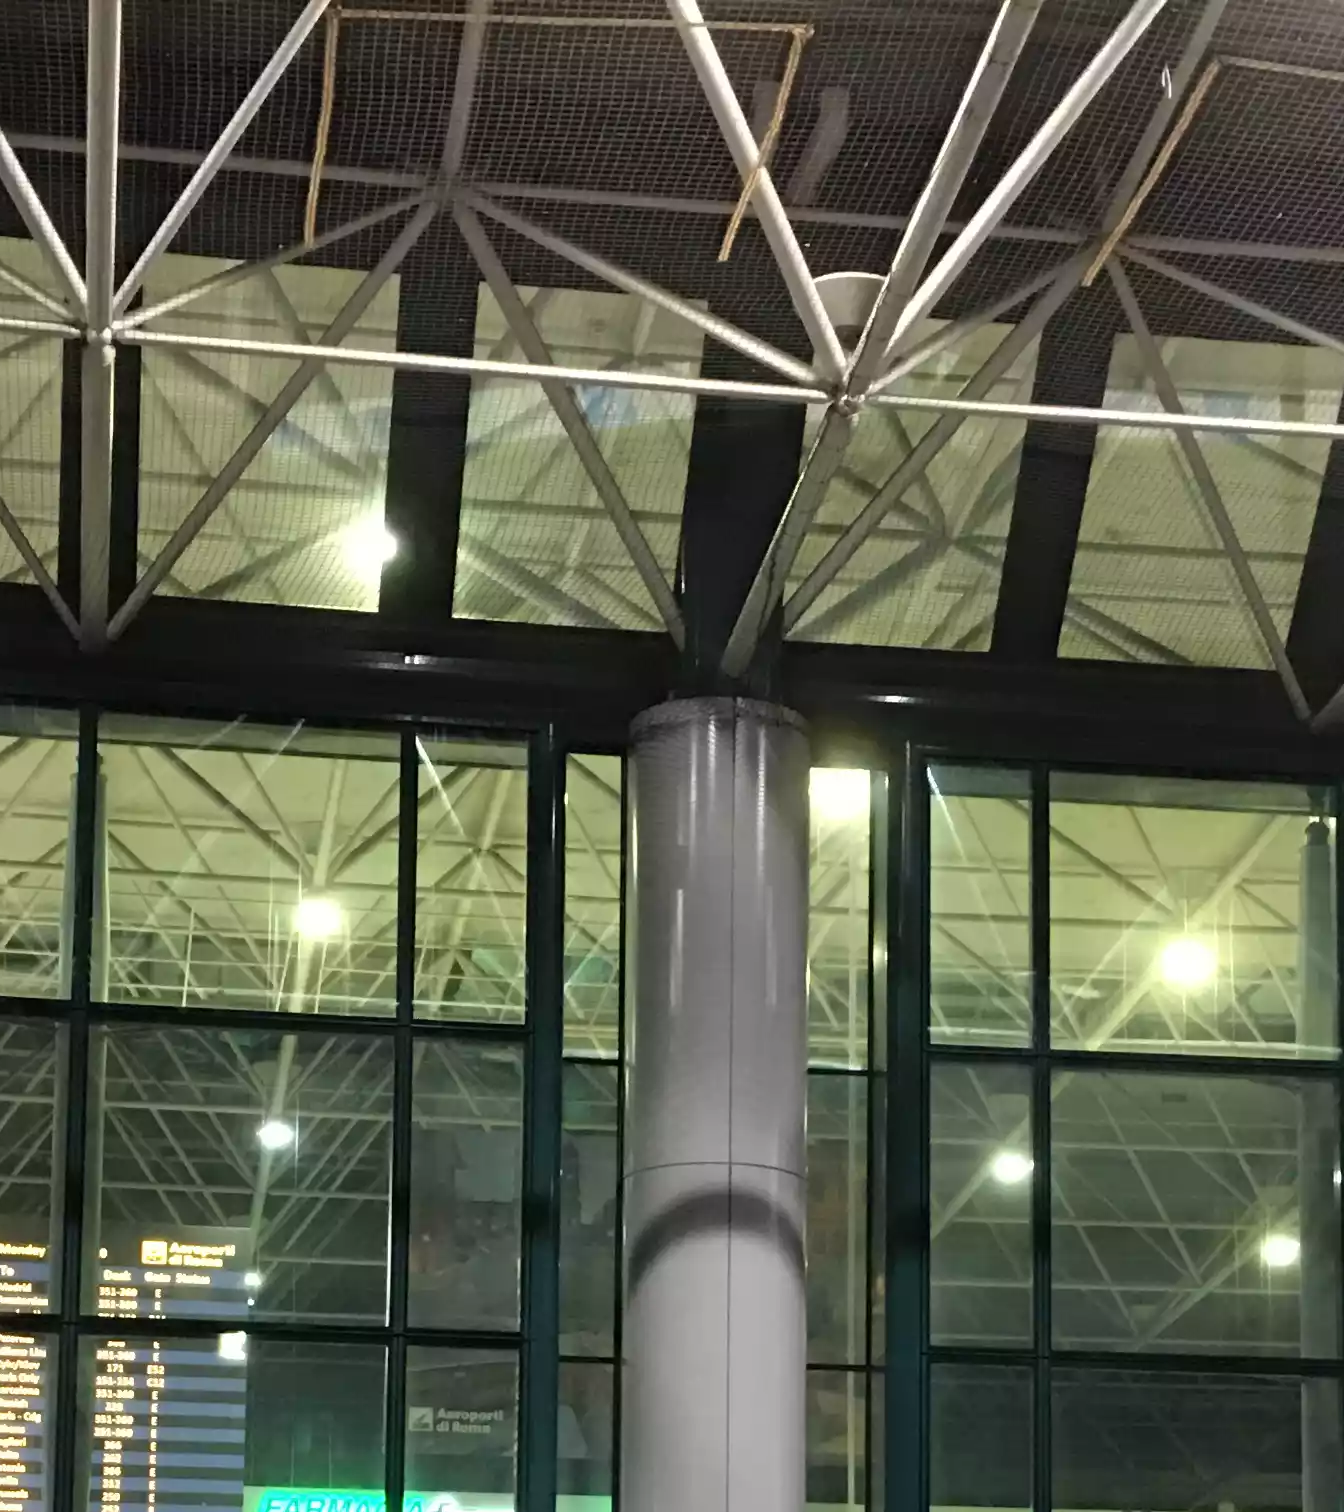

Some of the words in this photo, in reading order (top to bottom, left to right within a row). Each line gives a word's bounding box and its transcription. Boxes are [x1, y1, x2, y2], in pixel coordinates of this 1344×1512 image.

[0, 1243, 46, 1257] Monday
[169, 1242, 235, 1257] Aeroporti
[169, 1255, 182, 1266] di
[185, 1256, 223, 1267] Roma
[0, 1265, 15, 1276] To
[107, 1364, 123, 1373] 171
[436, 1408, 504, 1422] Aeroporti
[436, 1421, 450, 1433] di
[452, 1422, 491, 1434] Roma
